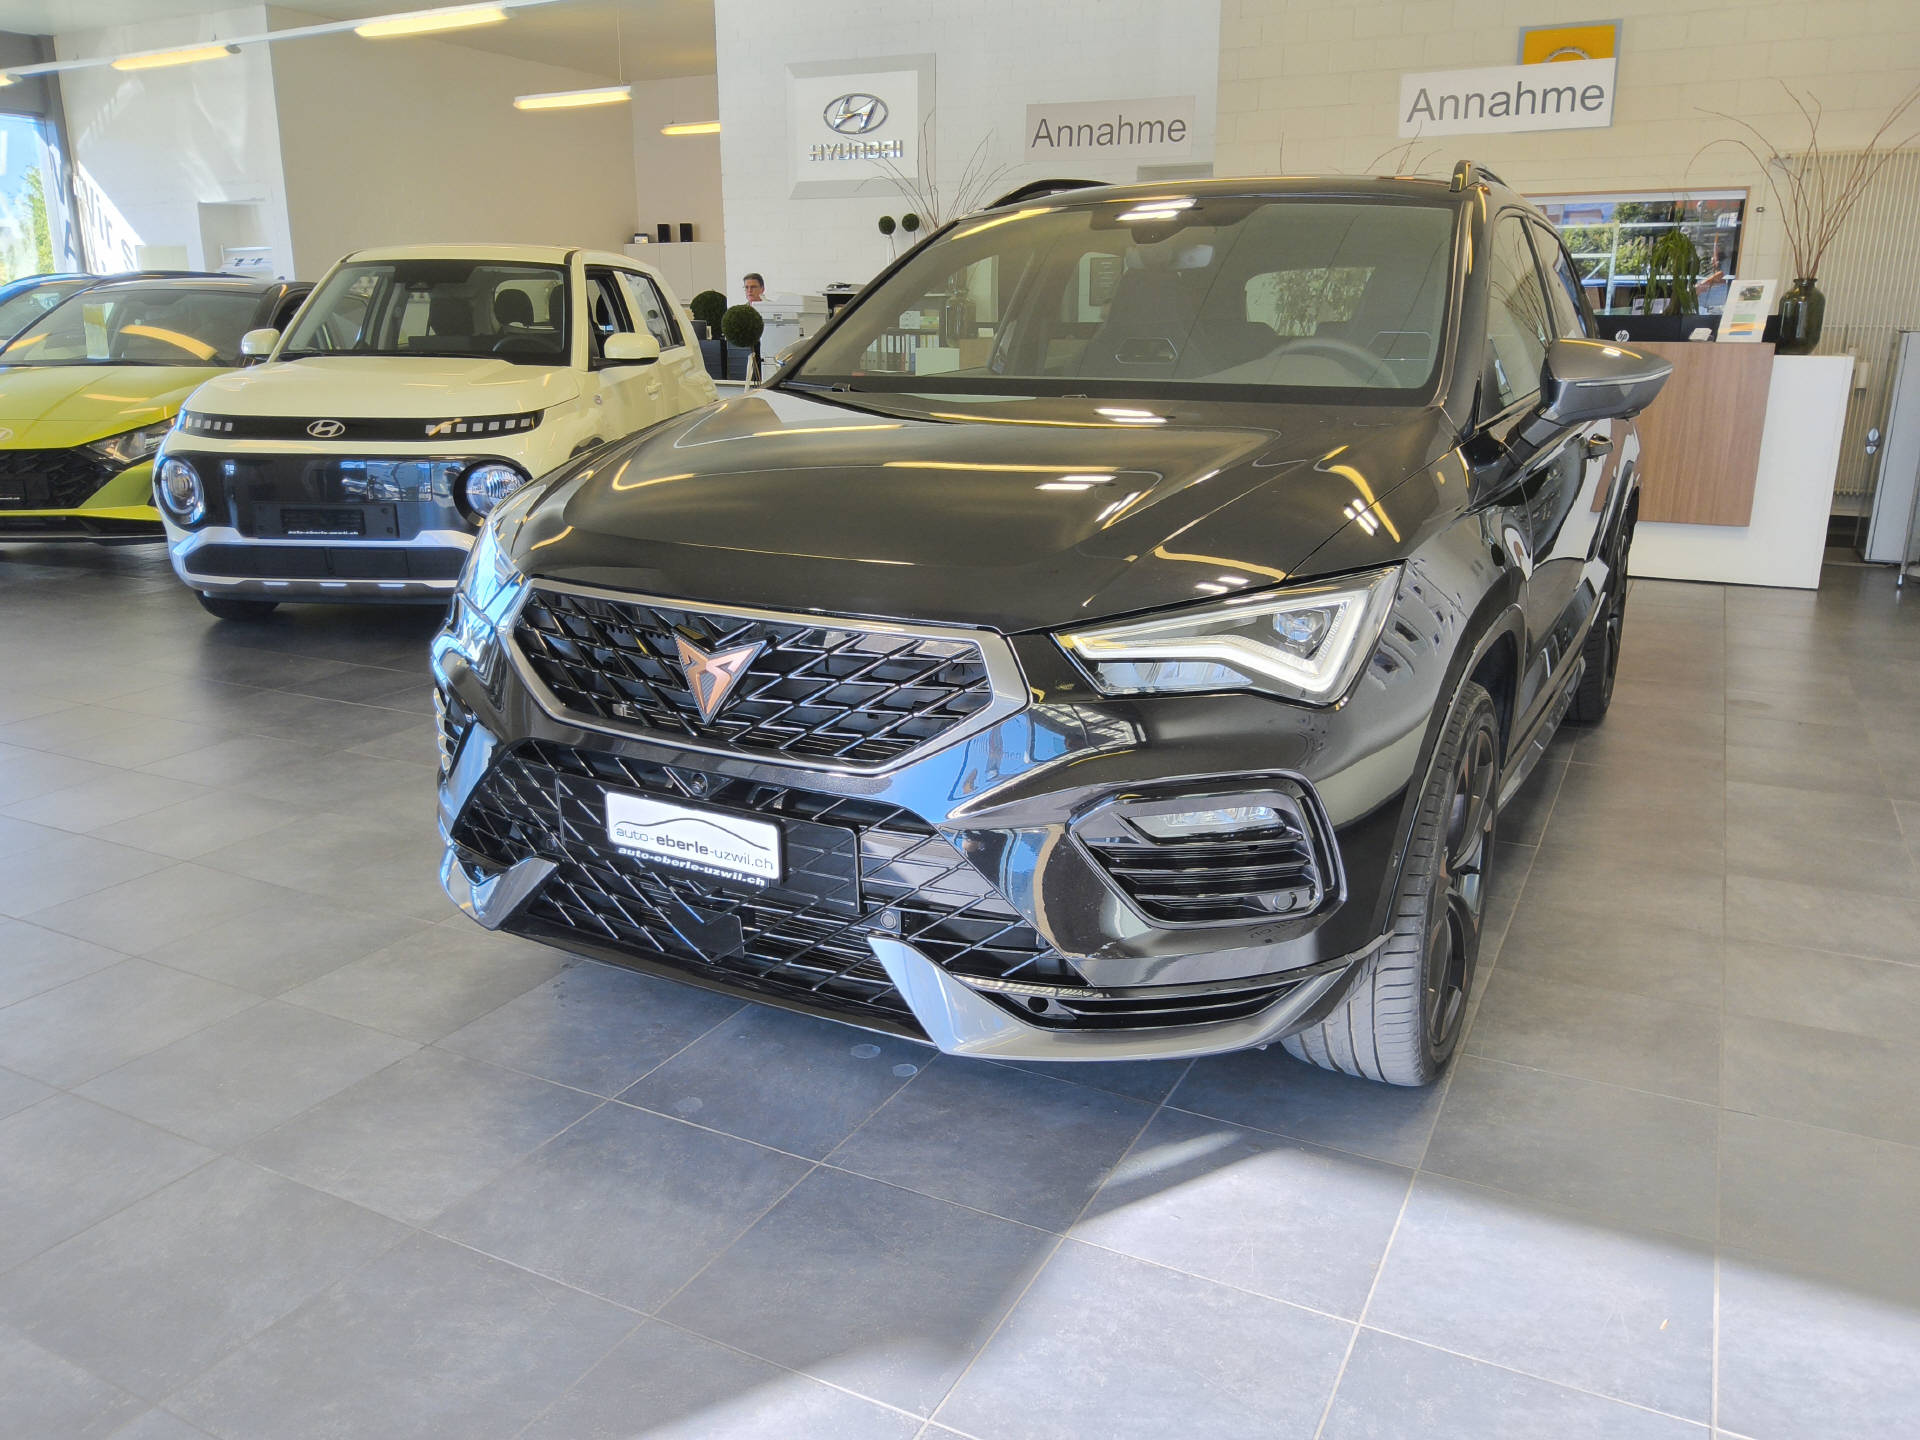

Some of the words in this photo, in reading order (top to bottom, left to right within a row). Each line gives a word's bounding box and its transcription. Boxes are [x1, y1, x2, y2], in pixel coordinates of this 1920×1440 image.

[1406, 81, 1605, 122] Annahme
[1031, 114, 1187, 148] Annahme
[808, 140, 904, 161] HYUNDAI
